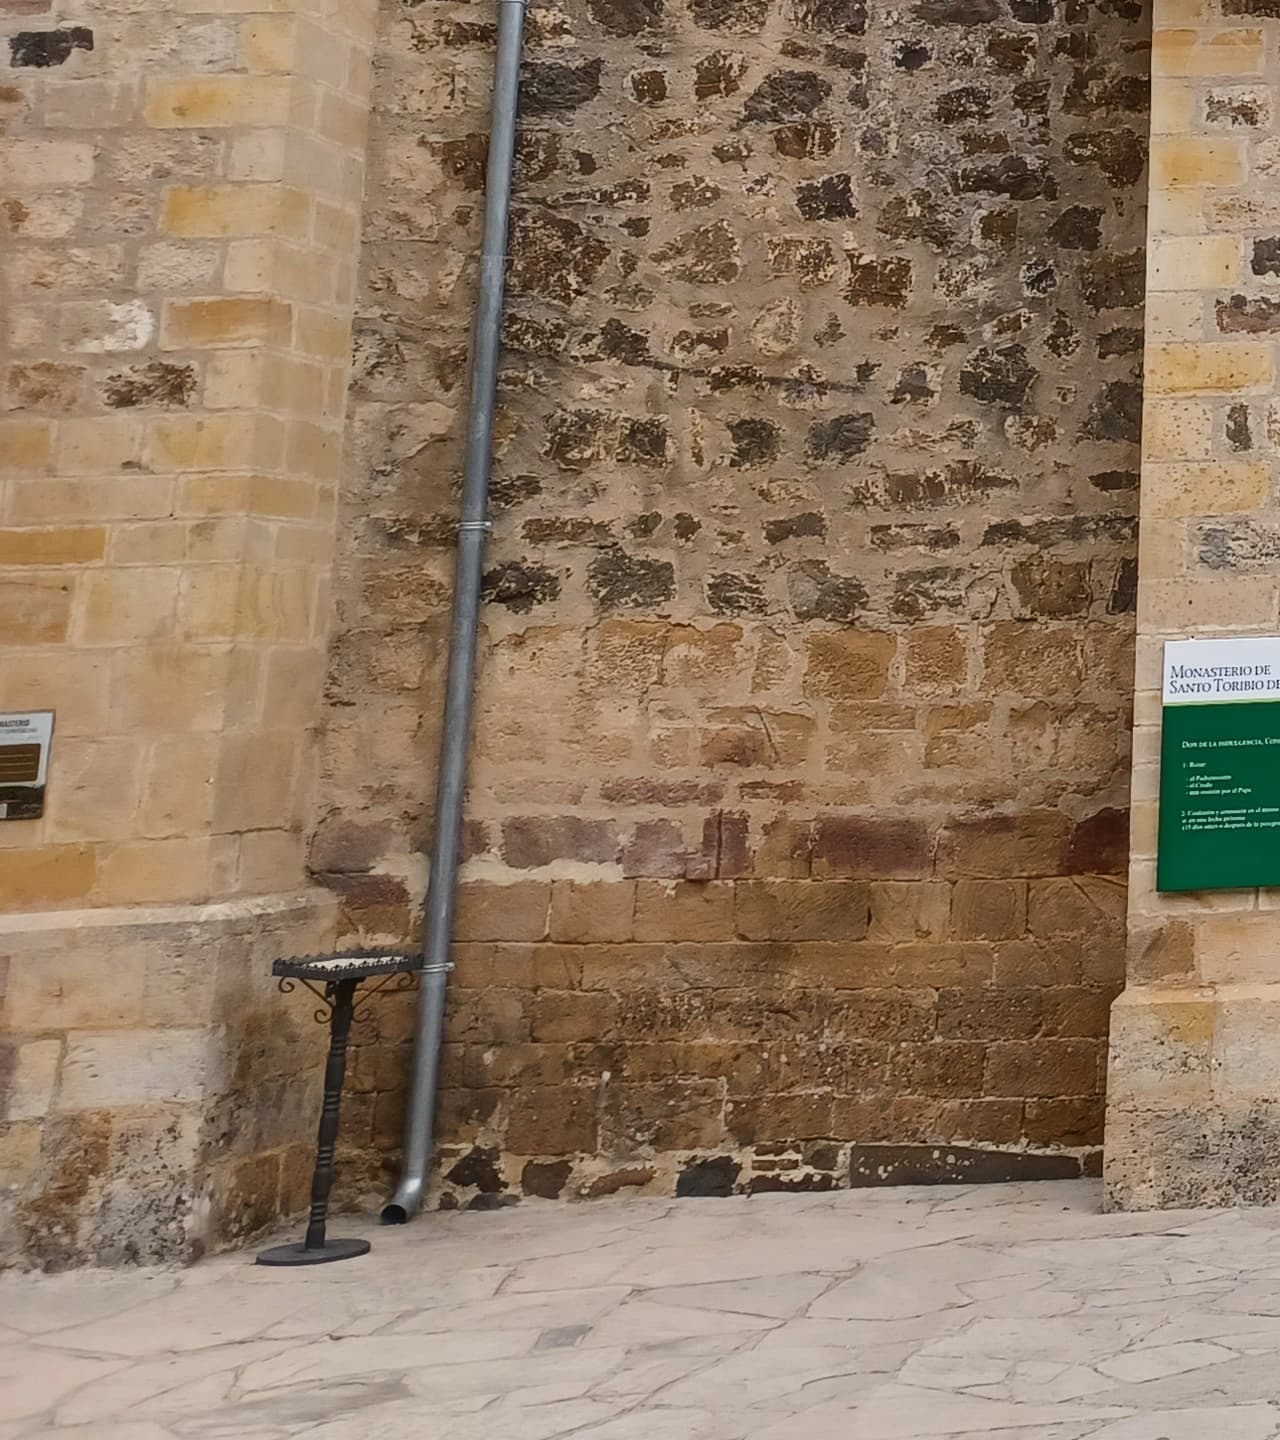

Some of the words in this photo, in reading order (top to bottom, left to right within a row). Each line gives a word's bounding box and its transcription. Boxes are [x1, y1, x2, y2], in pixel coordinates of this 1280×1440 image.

[1170, 665, 1252, 679] MONASTERIO
[1255, 665, 1271, 676] DE
[1170, 680, 1212, 694] SANTO
[1213, 678, 1264, 692] TORIBIO
